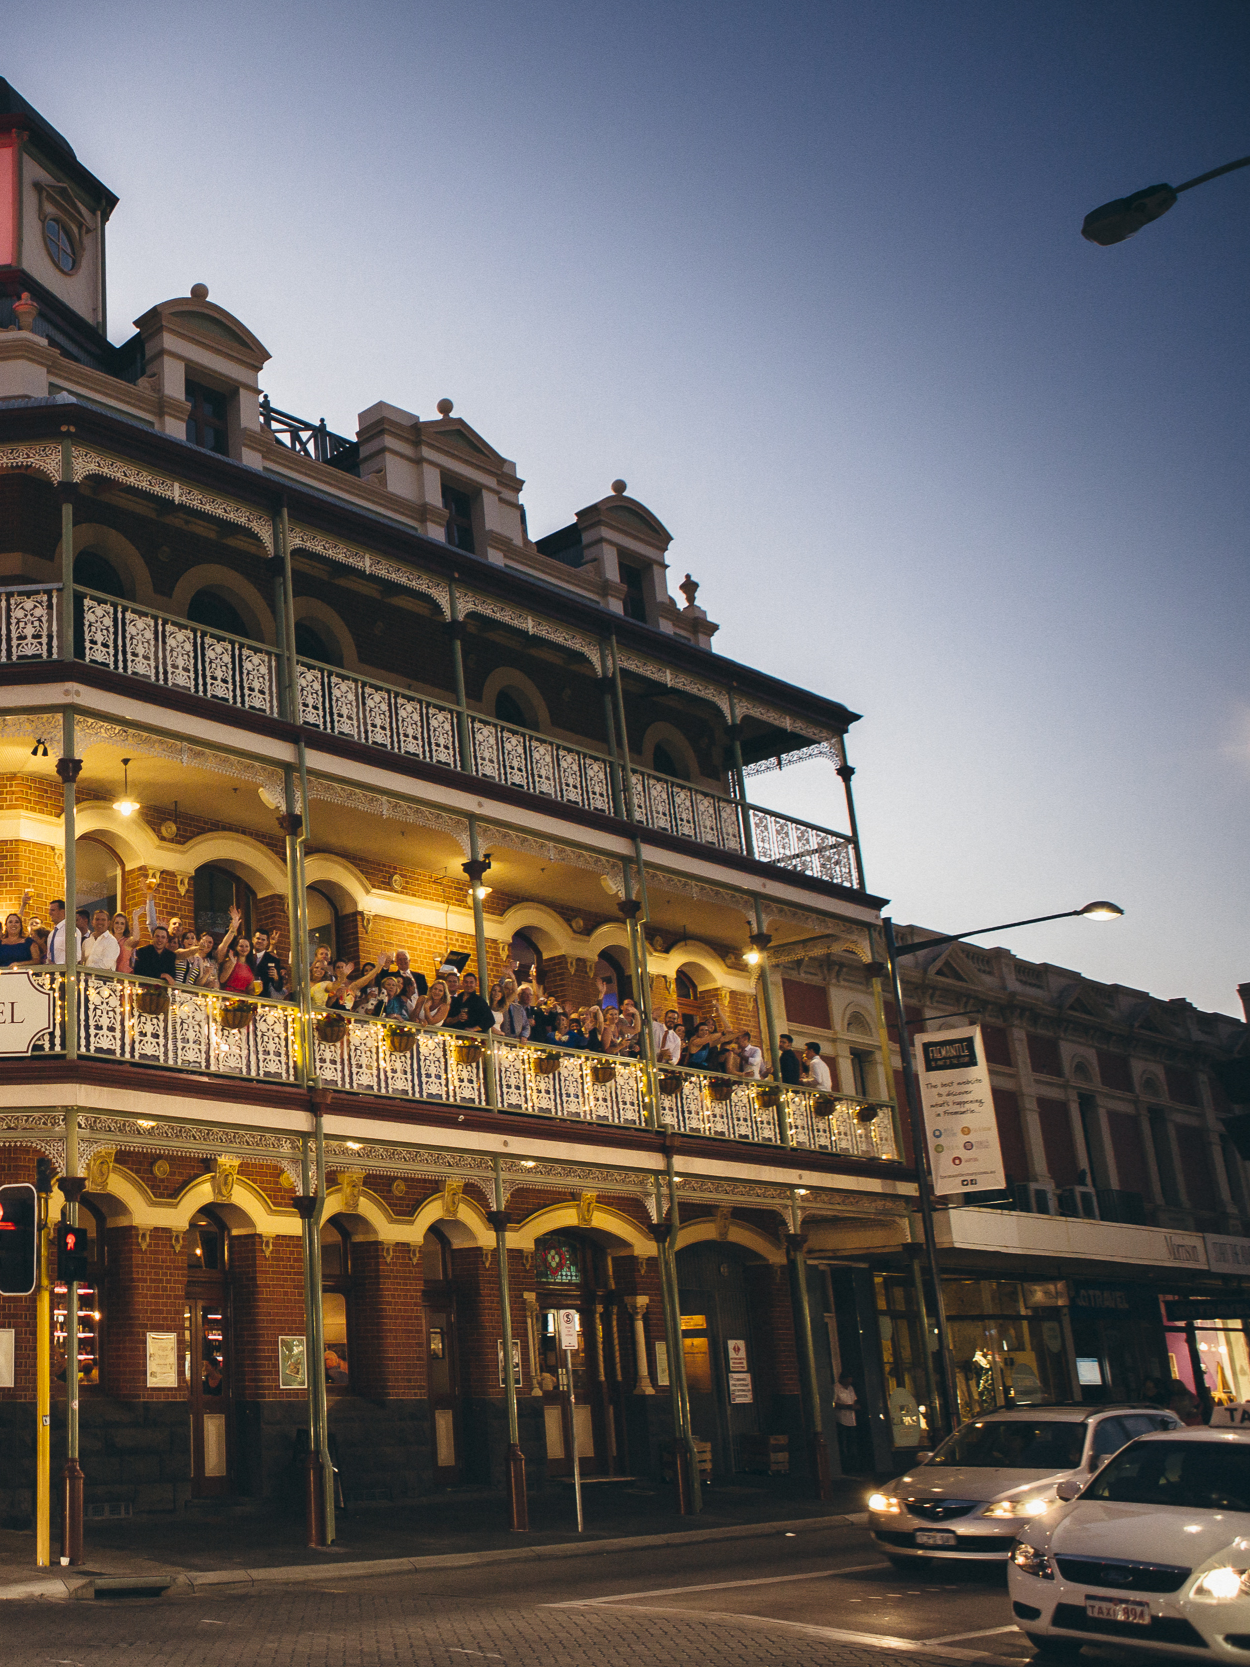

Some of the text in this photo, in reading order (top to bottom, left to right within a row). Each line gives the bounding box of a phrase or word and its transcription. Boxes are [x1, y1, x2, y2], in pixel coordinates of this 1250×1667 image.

[925, 1081, 938, 1089] The
[956, 1078, 983, 1086] website
[945, 1089, 973, 1097] discover
[952, 1098, 985, 1108] happening
[1089, 1604, 1117, 1618] TAXI
